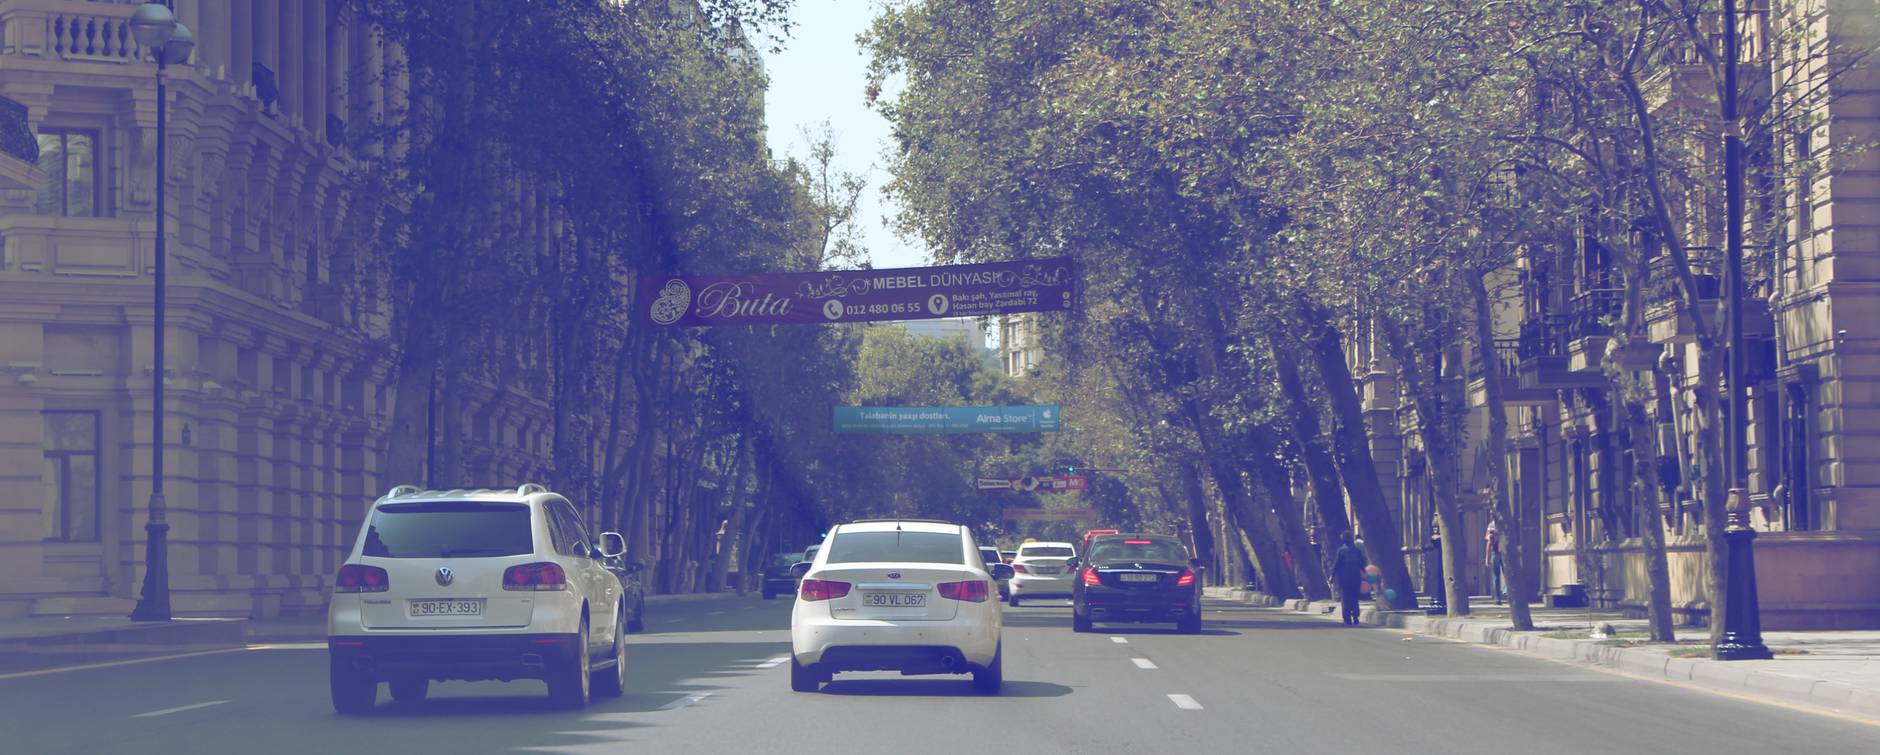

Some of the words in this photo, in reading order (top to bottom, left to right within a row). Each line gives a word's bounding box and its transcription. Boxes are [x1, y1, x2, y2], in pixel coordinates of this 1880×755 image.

[873, 276, 927, 290] MEBEL
[930, 271, 996, 287] DÜNYASI
[695, 281, 794, 318] Buta
[952, 294, 970, 302] Bakı
[989, 290, 1023, 299] Yasamal
[1023, 289, 1039, 298] ray,
[846, 305, 866, 315] 012
[868, 304, 889, 314] 480
[891, 303, 905, 313] 06
[907, 302, 921, 312] 55
[952, 302, 977, 310] Həsən
[979, 301, 994, 309] bəy
[995, 298, 1026, 307] Zərdabi
[1027, 297, 1038, 305] 72
[898, 412, 918, 421] yaxşı
[976, 414, 1001, 423] Alma
[1003, 413, 1028, 423] Store
[873, 594, 886, 605] 90
[889, 594, 901, 605] VL
[904, 594, 924, 605] 067
